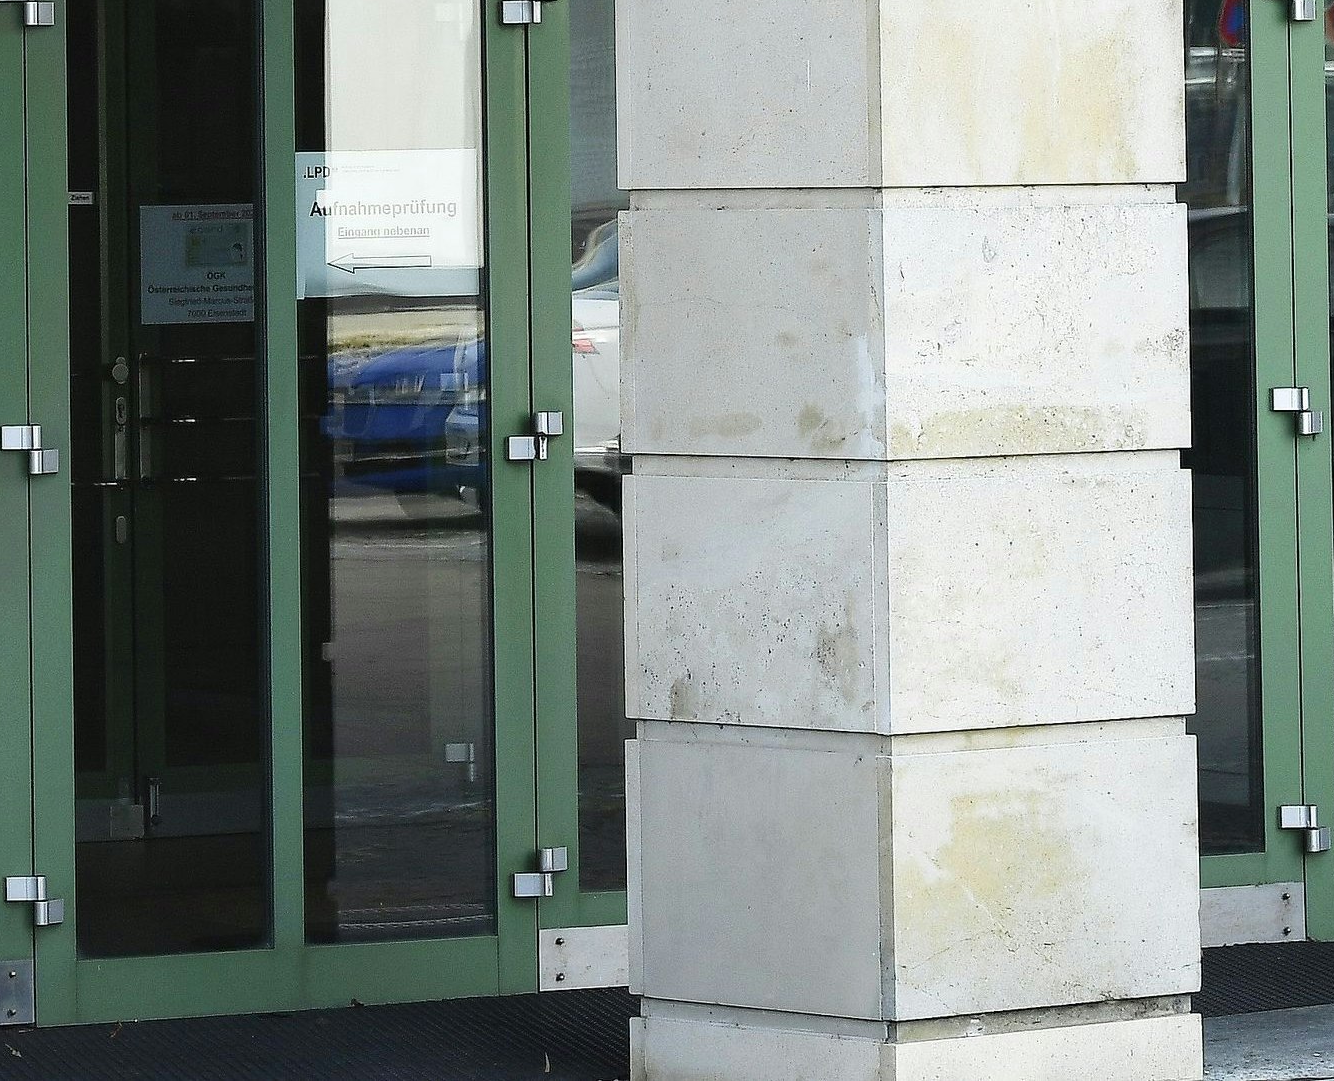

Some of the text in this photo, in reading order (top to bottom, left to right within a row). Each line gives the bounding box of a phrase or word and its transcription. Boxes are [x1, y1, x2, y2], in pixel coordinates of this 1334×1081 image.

[310, 199, 457, 218] Aufnahmeprüfung
[338, 225, 430, 238] Eingang nebenan
